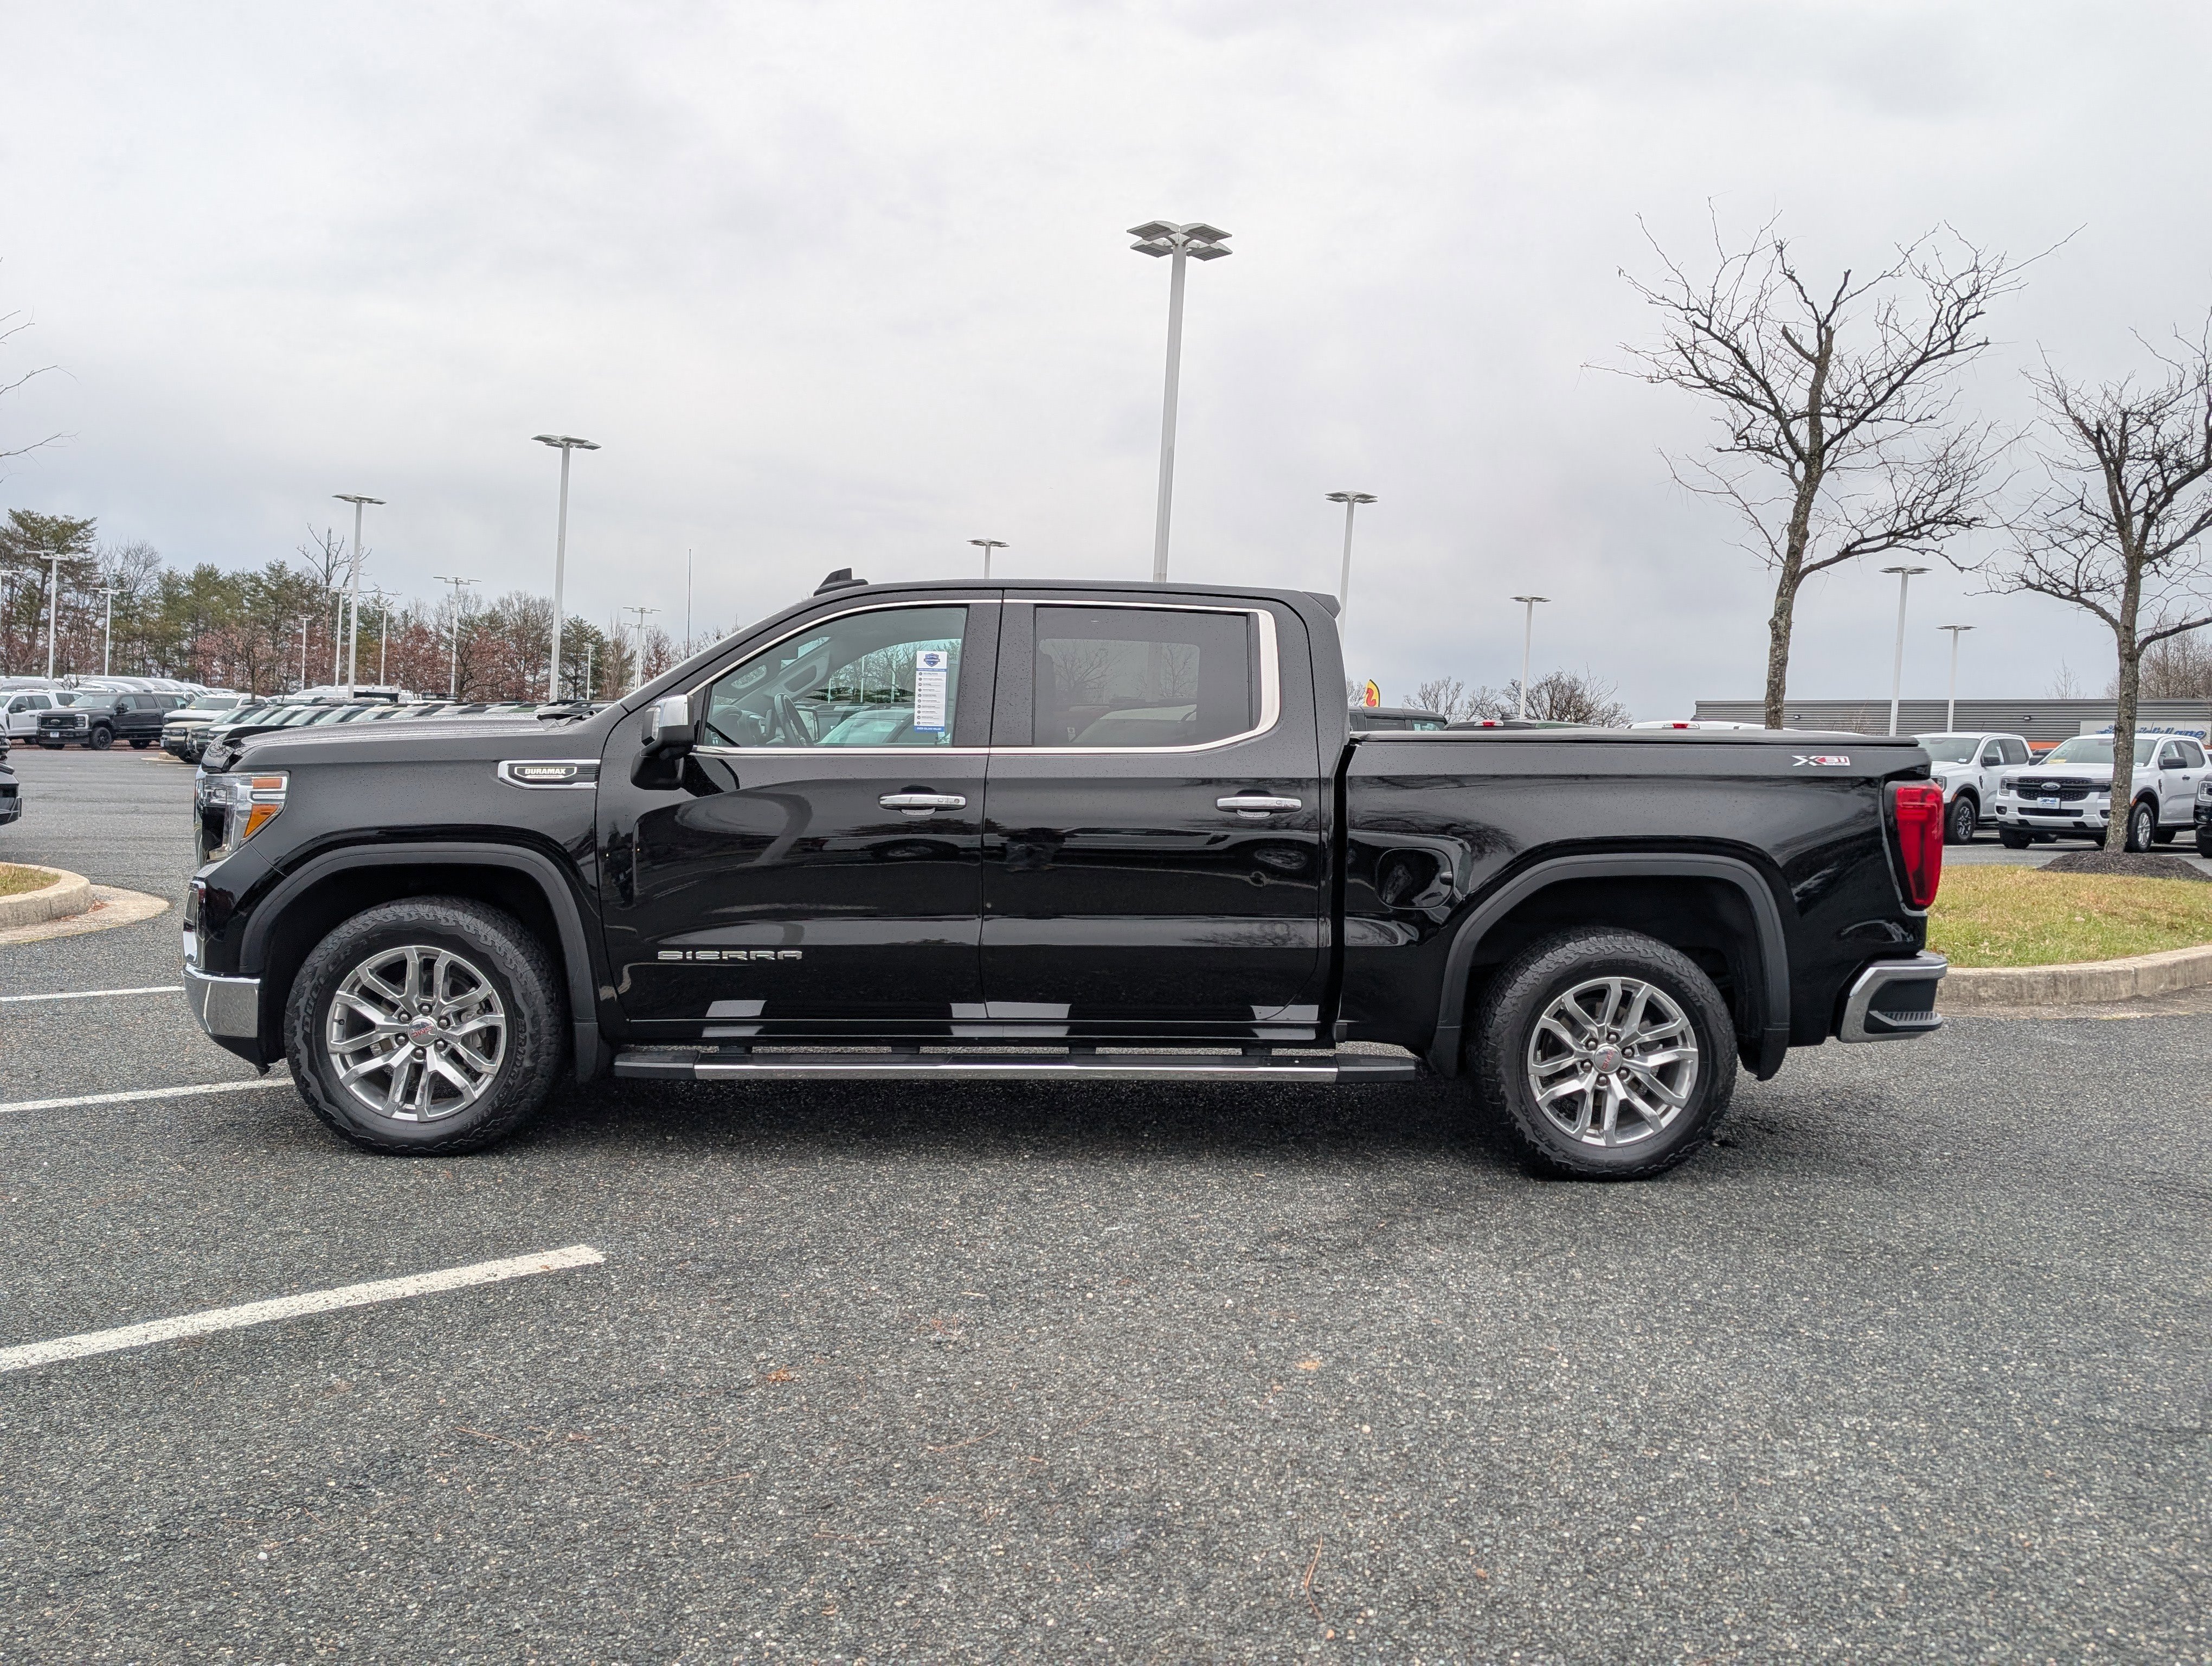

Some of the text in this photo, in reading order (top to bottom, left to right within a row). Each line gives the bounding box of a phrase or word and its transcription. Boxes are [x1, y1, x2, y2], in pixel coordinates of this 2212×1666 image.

[658, 951, 802, 960] SIERRA
[411, 1024, 434, 1038] GMC
[1601, 1048, 1615, 1070] GMC
[463, 1017, 527, 1129] BRIDGESTONE
